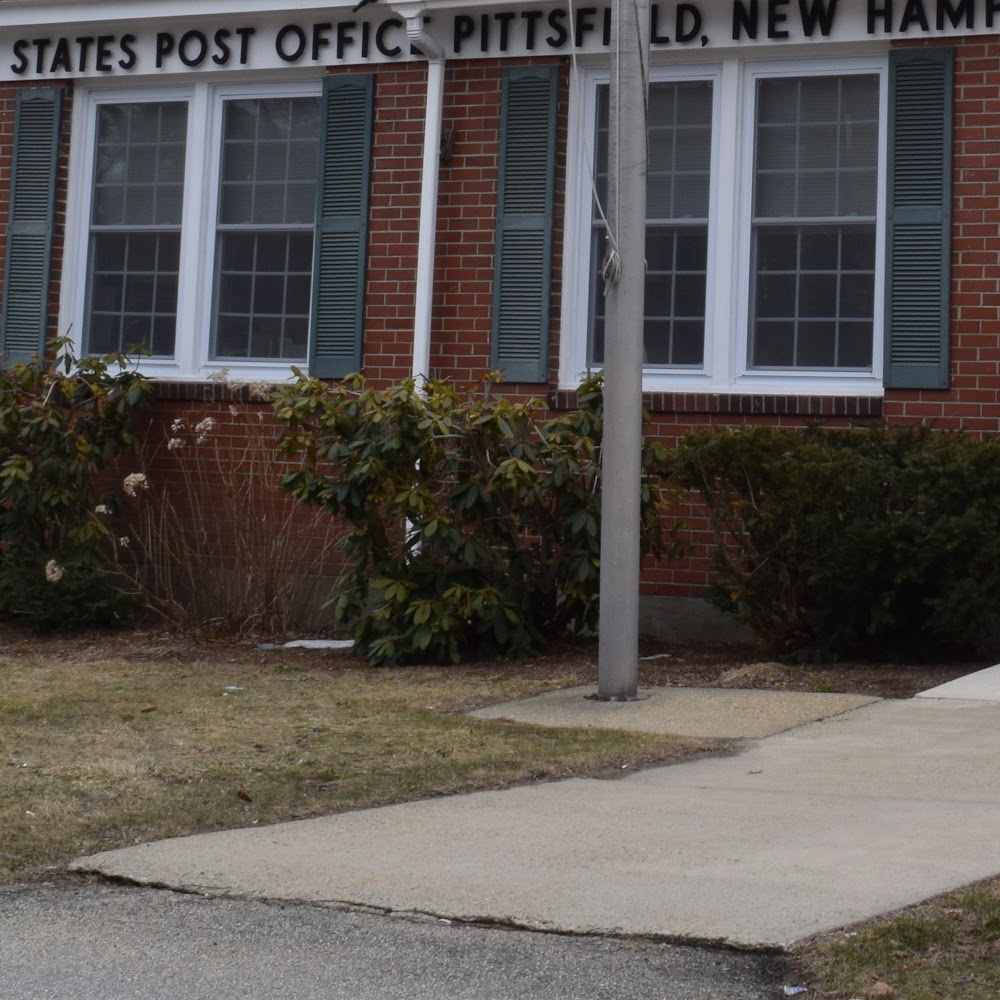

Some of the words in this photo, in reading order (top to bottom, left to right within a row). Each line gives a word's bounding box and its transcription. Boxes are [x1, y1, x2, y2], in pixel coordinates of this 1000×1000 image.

[10, 33, 137, 75] STATES
[155, 27, 256, 69] POST
[275, 16, 430, 62] OFFIC
[453, 3, 709, 53] PITTSFILD,
